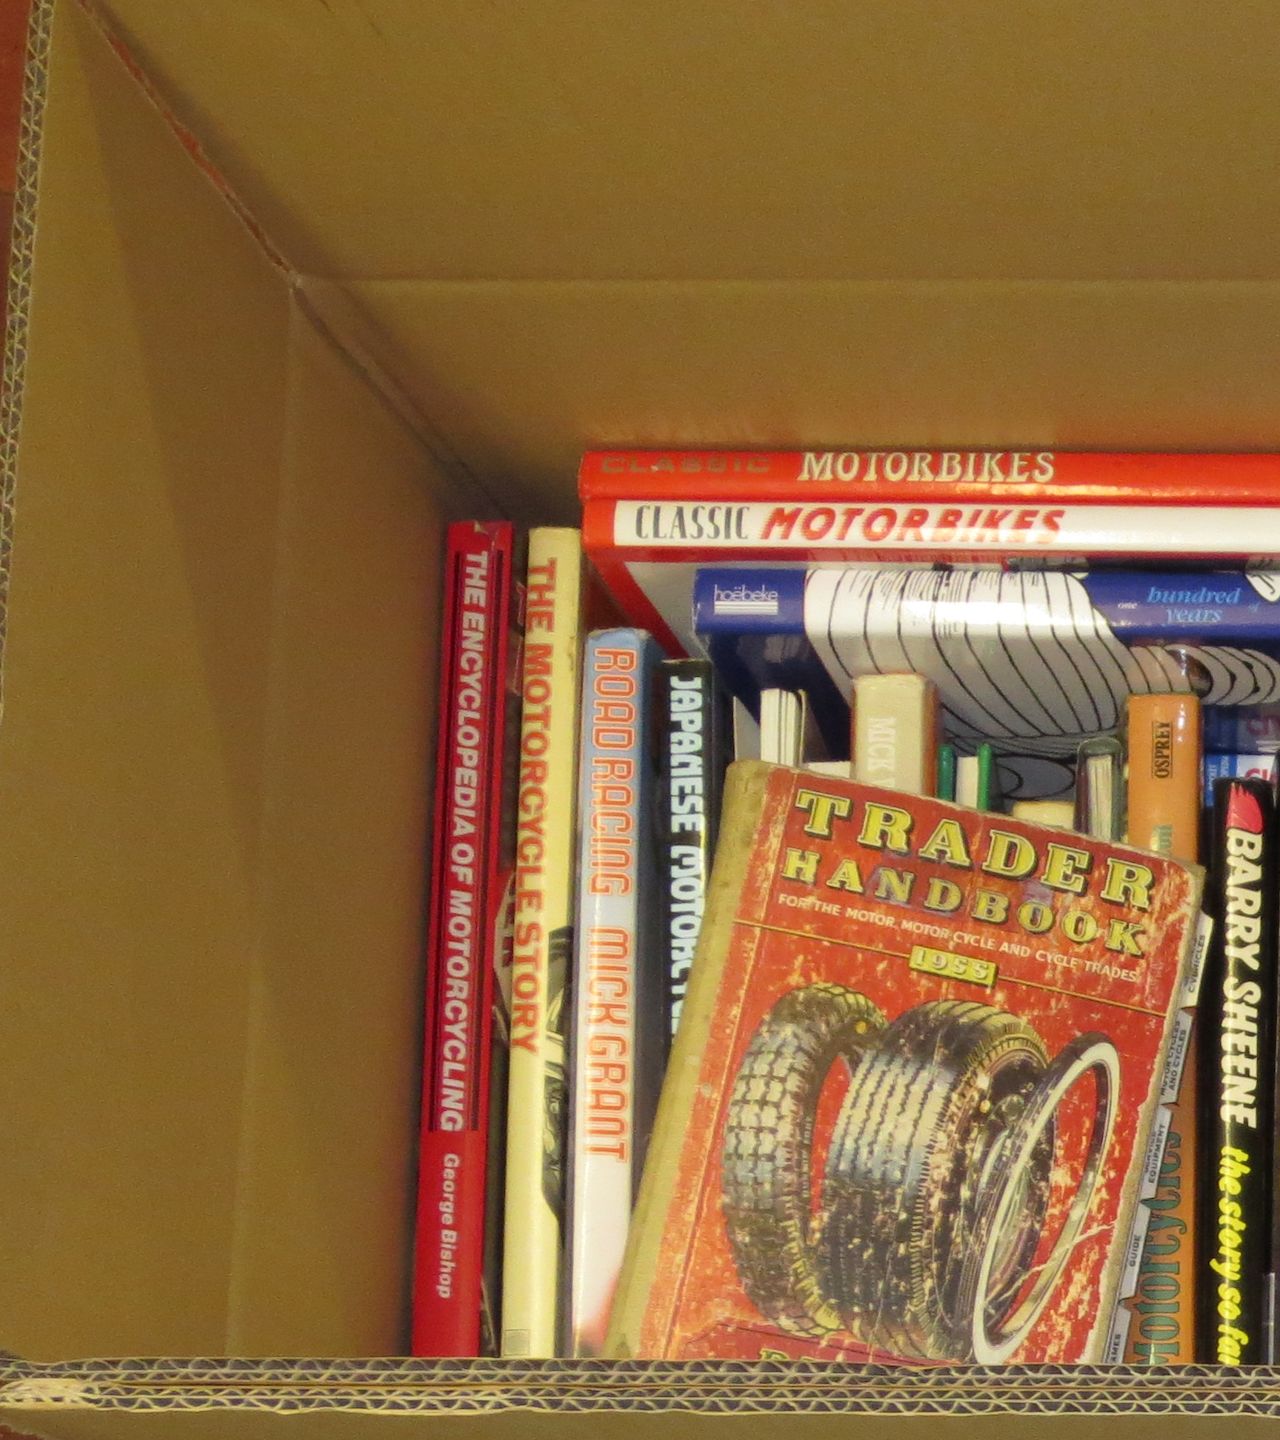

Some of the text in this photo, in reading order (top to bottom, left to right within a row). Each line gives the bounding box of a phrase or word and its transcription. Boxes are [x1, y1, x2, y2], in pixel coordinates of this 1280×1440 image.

[797, 451, 1055, 482] MOTORBIKES
[635, 505, 1065, 542] CLASSIC MOTORBIKES
[1117, 600, 1137, 610] one
[1146, 585, 1241, 626] hundred years
[668, 674, 703, 832] JAPANESE
[1154, 721, 1172, 779] OSPREY
[510, 557, 557, 1054] THE MOTORCYCLE STORY
[795, 788, 1156, 910] TRADER
[436, 550, 488, 1299] THE ENCYCLOPEDIA OF MOTORCYCLING George Bishop
[583, 646, 637, 1163] ROAD RACING MICK GRANT
[780, 848, 1144, 956] HANDBOOK
[914, 948, 990, 980] 1955
[1209, 828, 1263, 1320] BARRY SHEENE the story so
